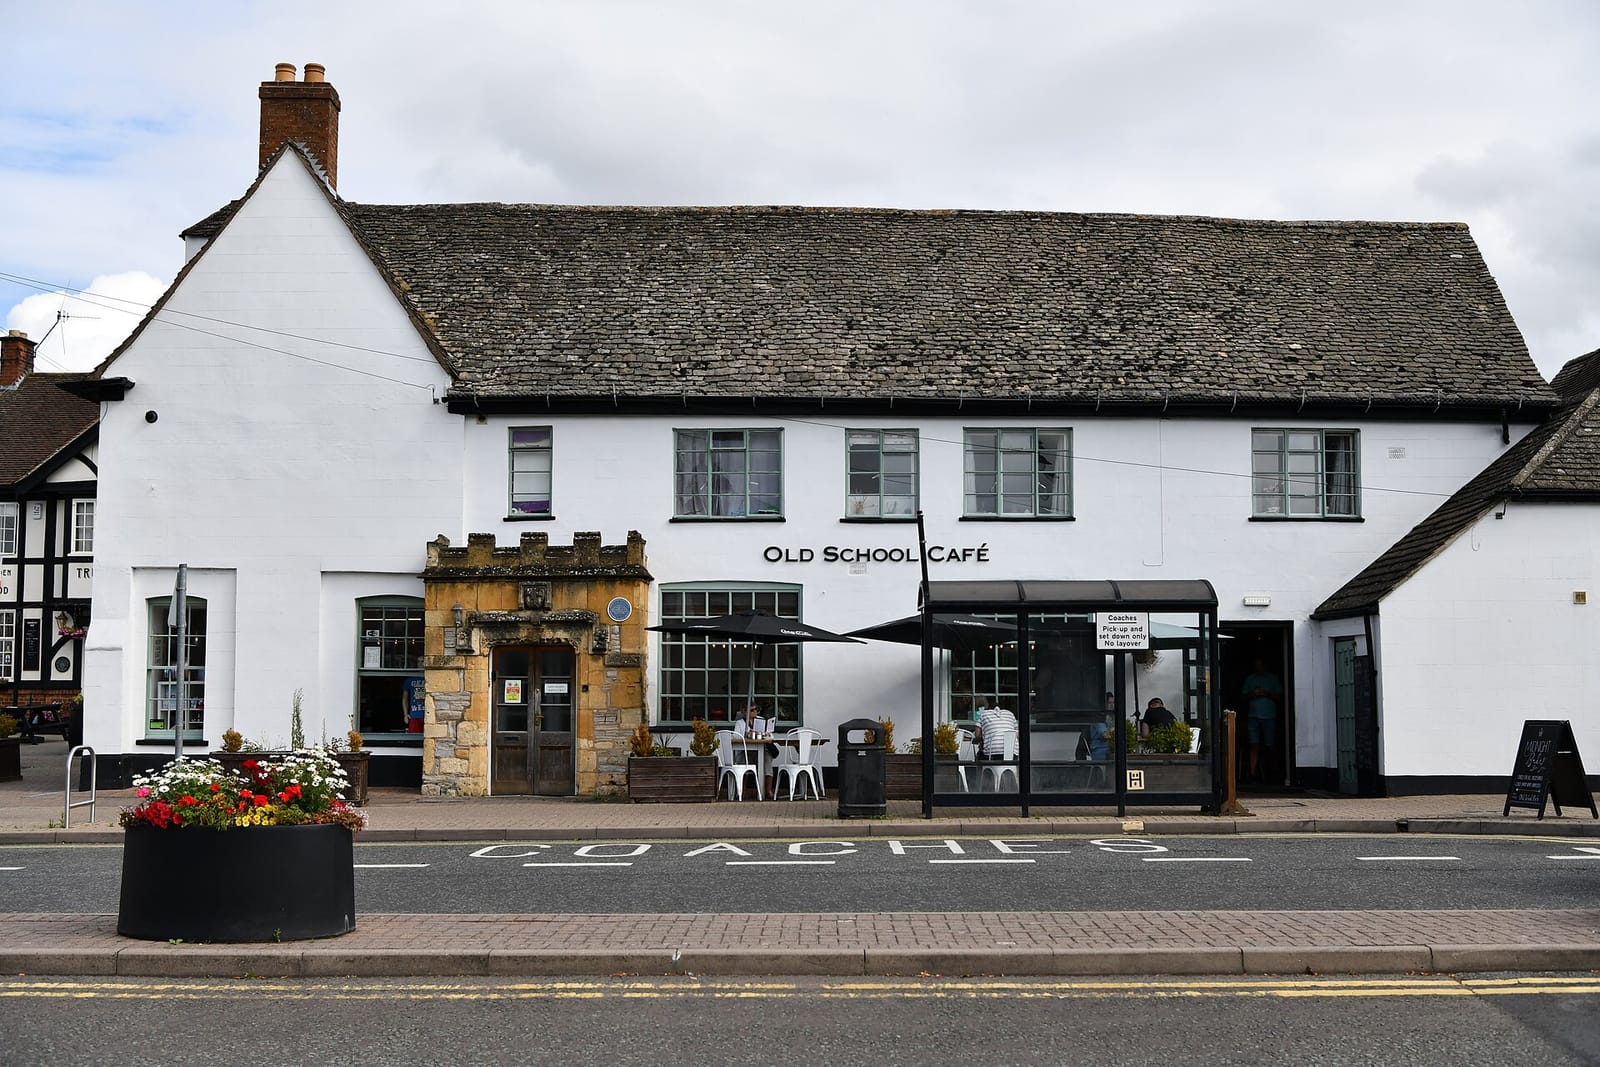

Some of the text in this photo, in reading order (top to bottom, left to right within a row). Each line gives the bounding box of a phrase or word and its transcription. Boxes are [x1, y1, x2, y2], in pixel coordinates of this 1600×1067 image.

[763, 543, 990, 563] OLD SCHOOL CAFÉ
[1129, 771, 1142, 788] H
[469, 839, 1169, 858] COACHES
